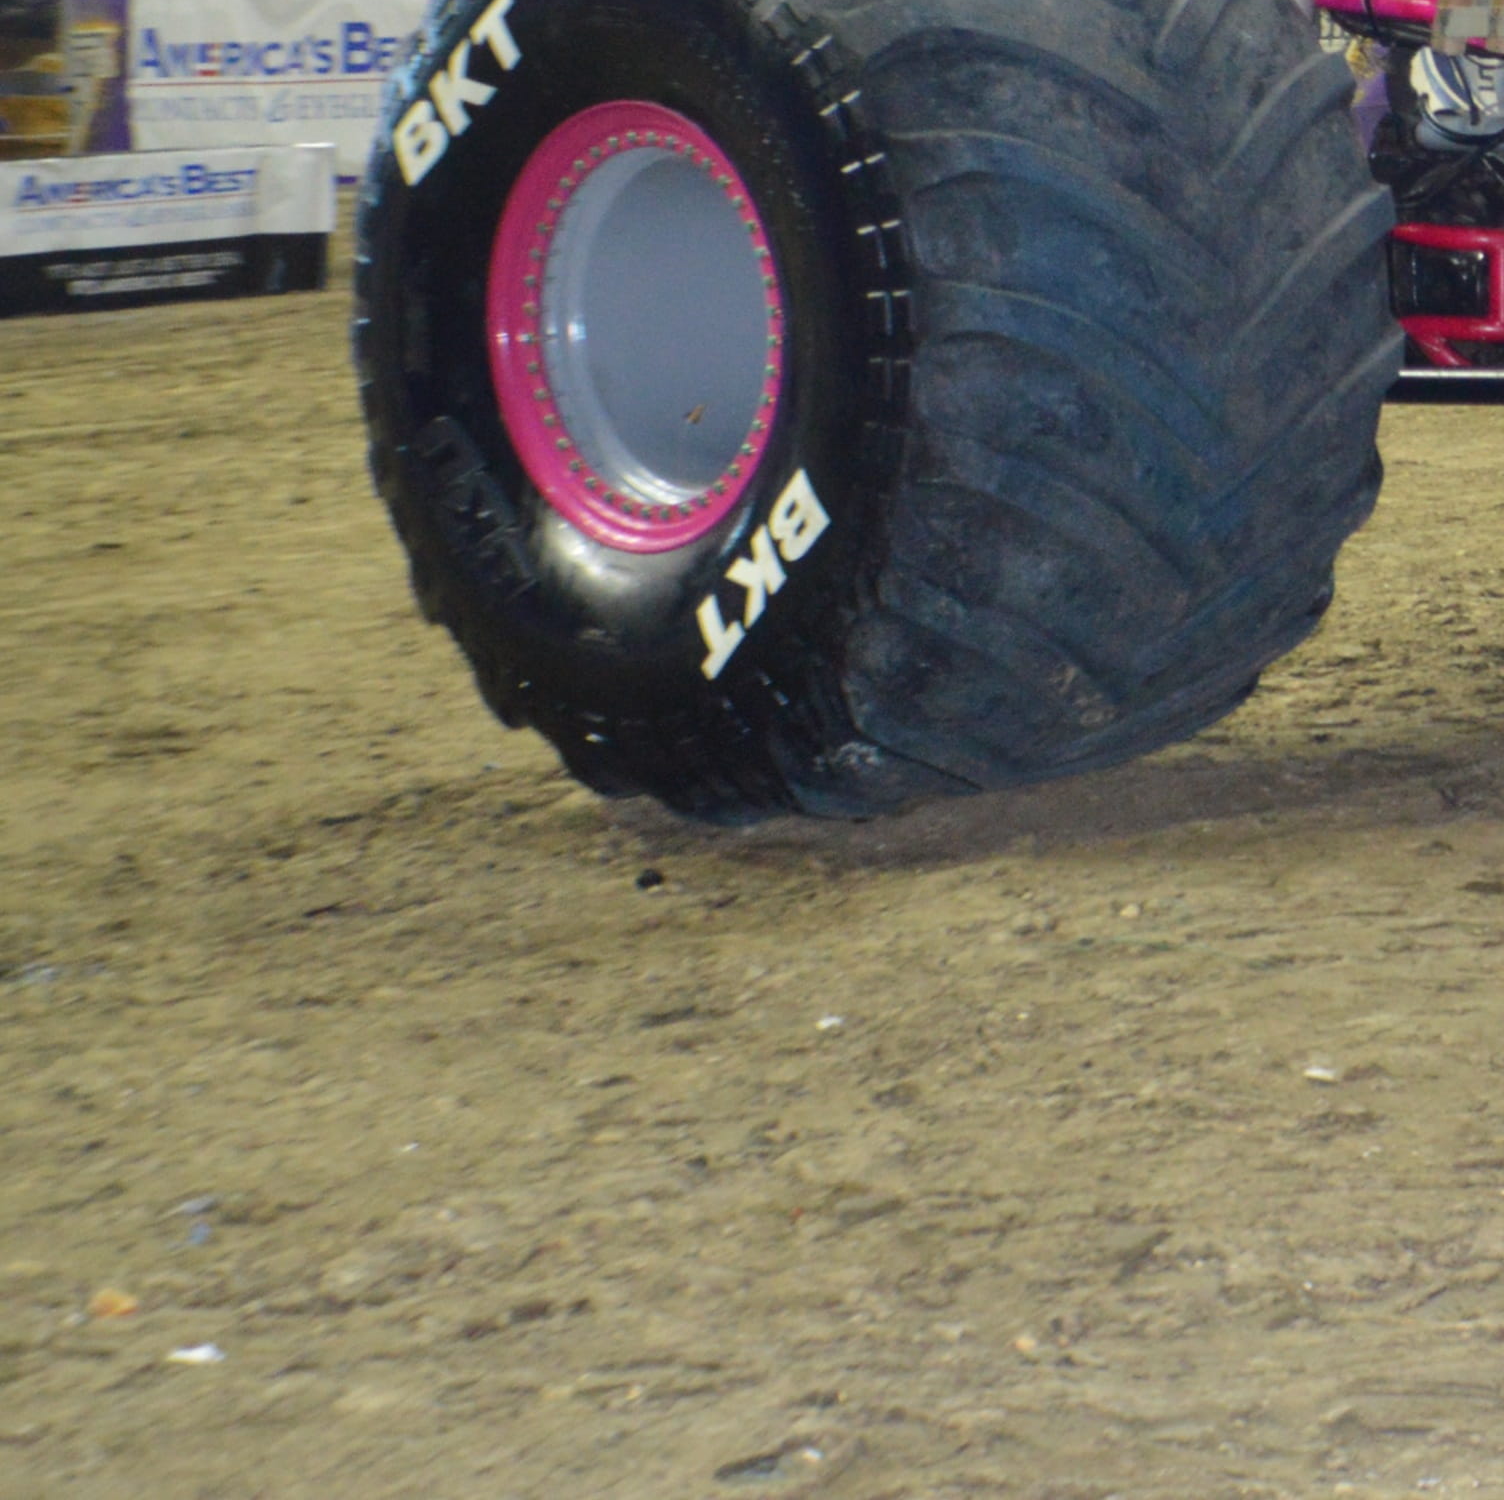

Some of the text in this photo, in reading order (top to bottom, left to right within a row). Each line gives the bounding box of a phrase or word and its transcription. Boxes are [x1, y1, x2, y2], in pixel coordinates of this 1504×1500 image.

[139, 21, 406, 78] AMERICA'S BE
[696, 467, 831, 682] BKT
